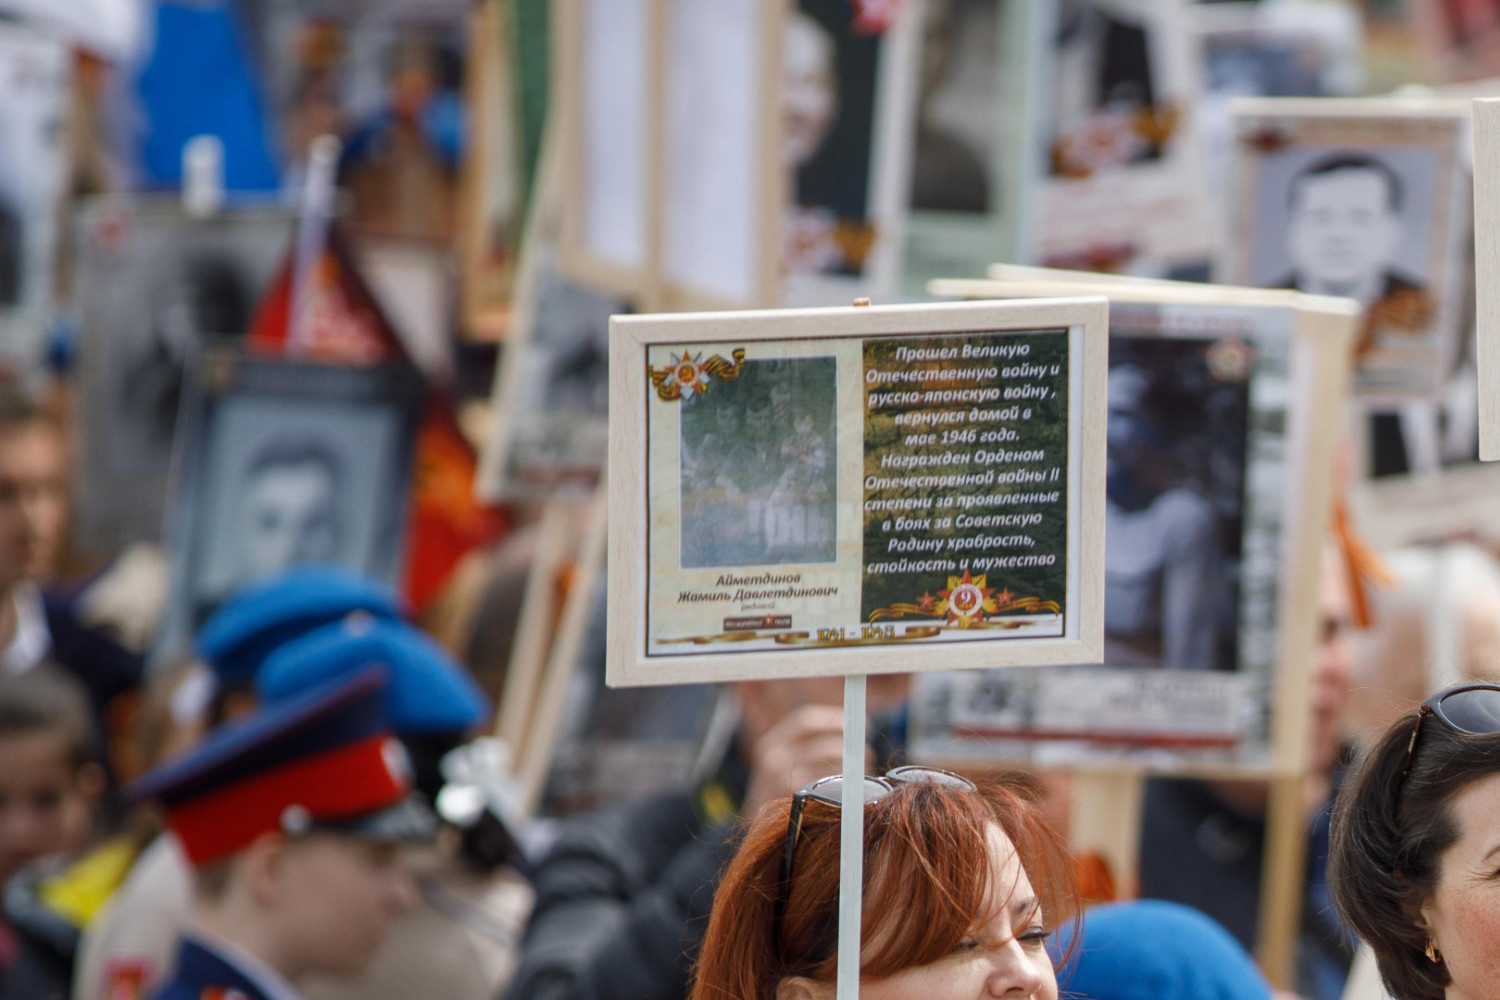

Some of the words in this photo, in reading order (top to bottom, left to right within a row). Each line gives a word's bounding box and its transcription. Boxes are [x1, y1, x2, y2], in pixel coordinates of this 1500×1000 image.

[896, 346, 957, 363] Прошел
[962, 344, 1030, 360] Великую
[866, 368, 998, 384] Отечественную
[1001, 363, 1047, 381] войну
[1051, 364, 1060, 376] и
[868, 387, 1000, 406] русско-японскую
[1003, 384, 1049, 400] войну
[895, 410, 965, 426] вернулся
[968, 406, 1019, 422] домой
[1022, 408, 1032, 420] в
[905, 433, 936, 446] мае
[941, 430, 977, 445] 1946
[980, 427, 1020, 443] года.
[881, 451, 970, 469] Награжден
[974, 448, 1044, 466] Орденом
[865, 470, 994, 490] Отечественной
[998, 468, 1046, 483] войны
[864, 496, 932, 511] степени
[935, 495, 951, 508] за
[957, 490, 1060, 509] проявленные
[882, 520, 891, 532] в
[895, 515, 930, 531] боях
[934, 516, 951, 528] за
[955, 512, 1042, 528] Советскую
[888, 538, 944, 553] Родину
[947, 534, 1035, 551] храбрость,
[867, 556, 955, 574] стойкость
[959, 558, 969, 570] и
[973, 553, 1056, 571] мужество
[716, 572, 801, 587] Айметдинов
[678, 590, 731, 603] Жамиль
[732, 586, 838, 602] Давлетдинович
[961, 590, 971, 604] 9
[740, 601, 775, 612] рядовой
